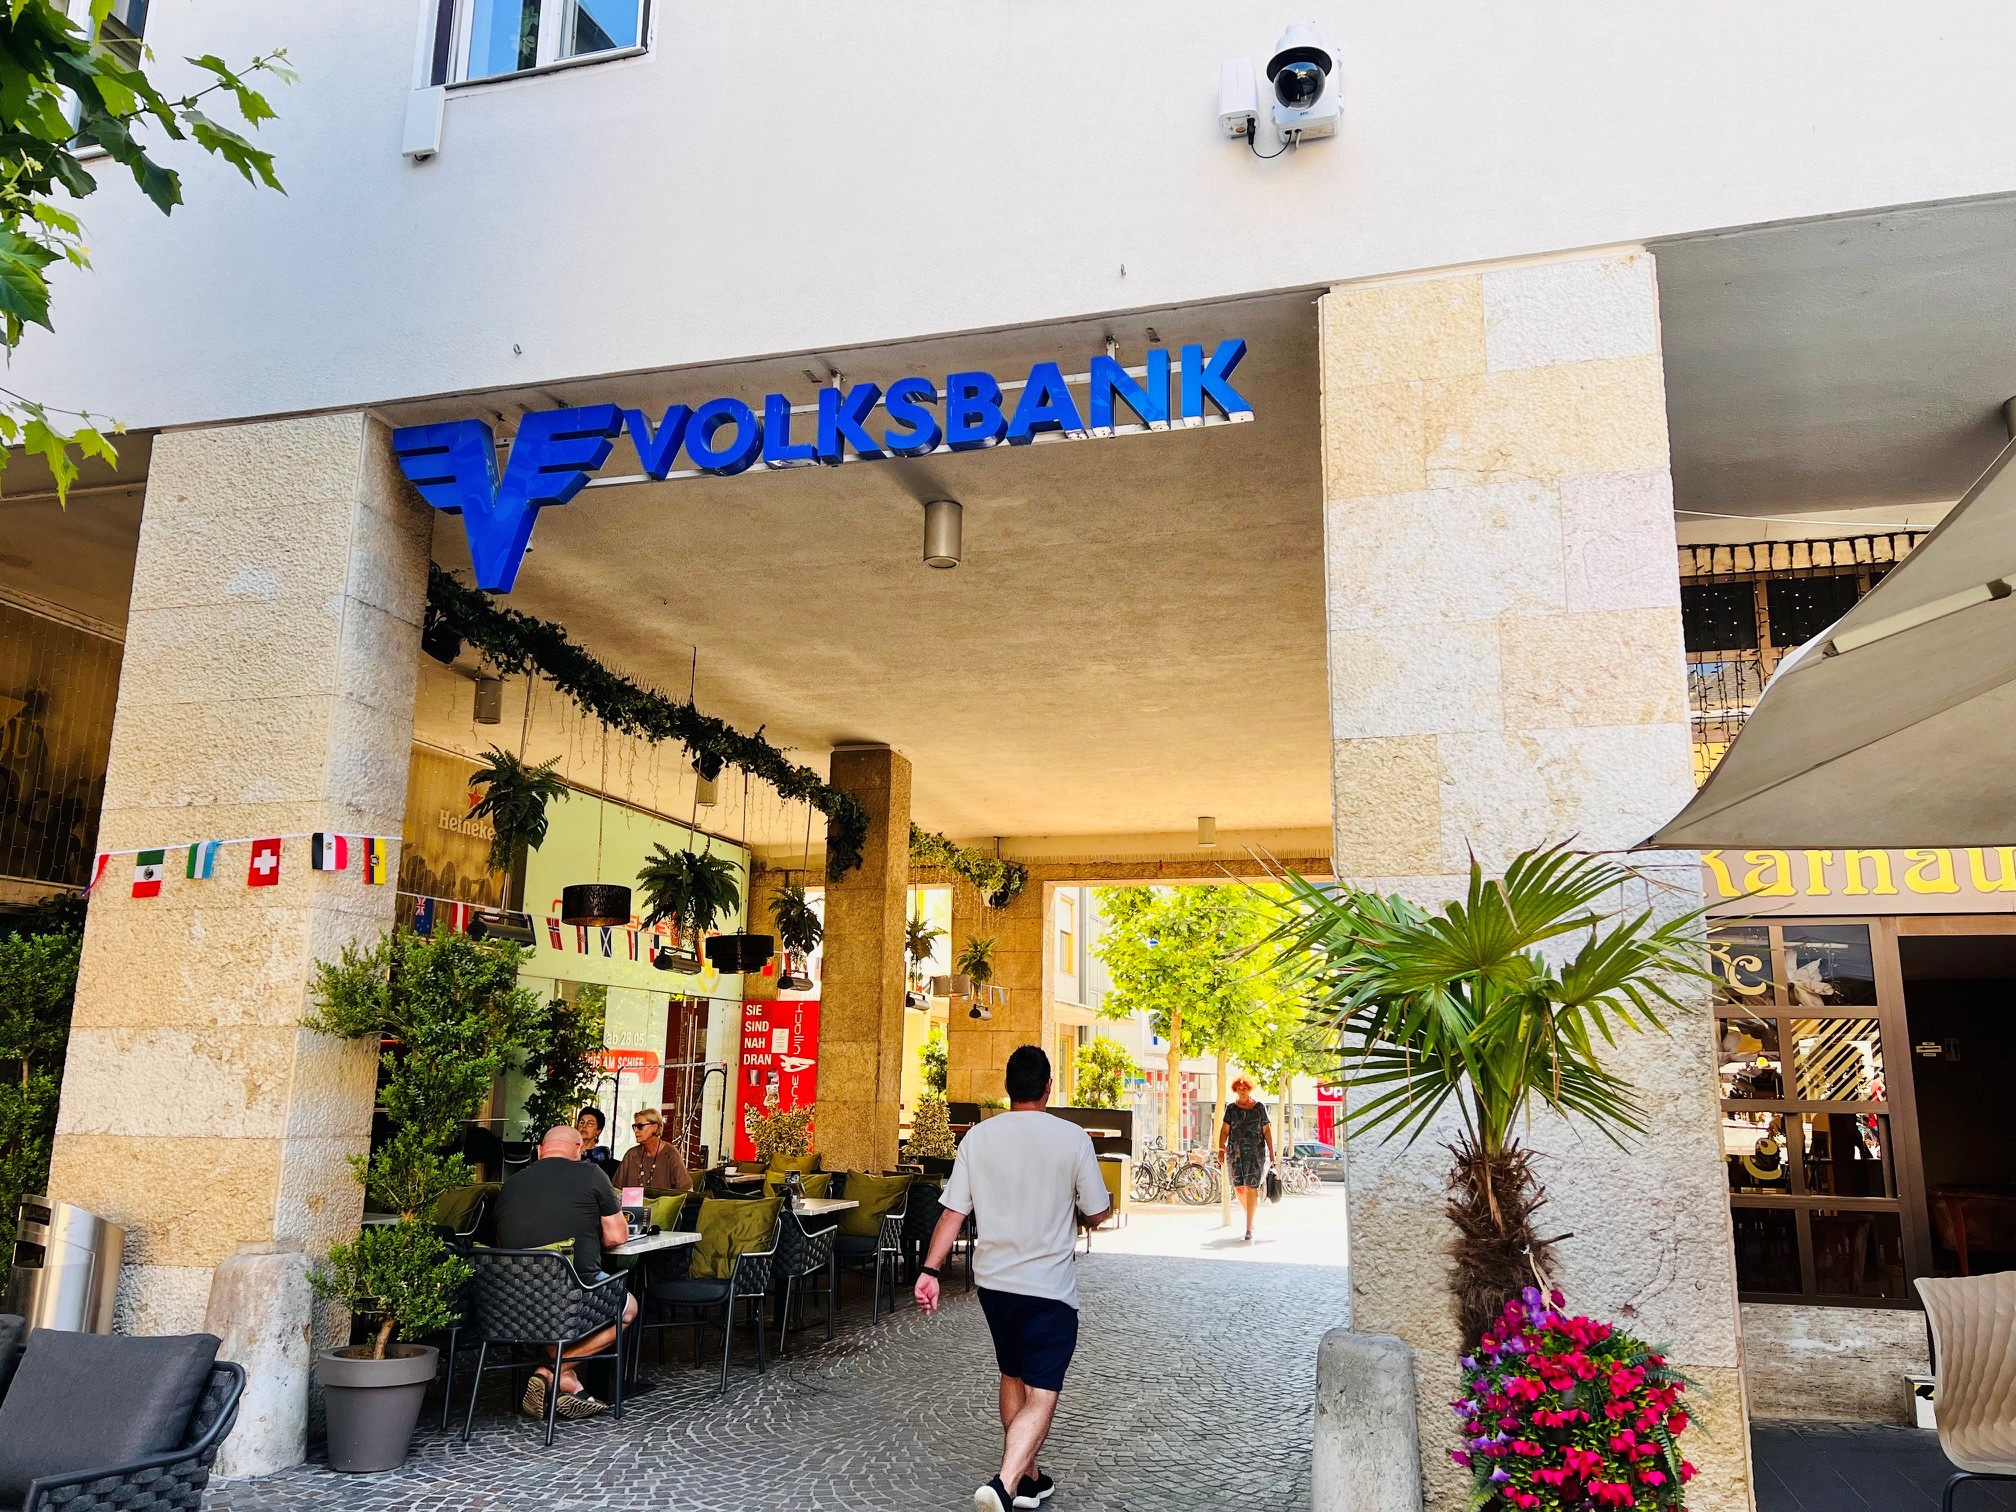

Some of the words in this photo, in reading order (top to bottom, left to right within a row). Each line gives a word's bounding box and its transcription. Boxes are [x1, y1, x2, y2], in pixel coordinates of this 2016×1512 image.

[621, 339, 1254, 480] VOLKSBANK
[438, 809, 497, 841] Heineke
[745, 1004, 763, 1016] SIE
[744, 1020, 770, 1032] SIND
[606, 1031, 618, 1045] ab
[744, 1037, 766, 1049] NAH
[602, 1056, 615, 1070] AM
[617, 1056, 644, 1070] SCHIFF
[743, 1053, 772, 1065] DRAN
